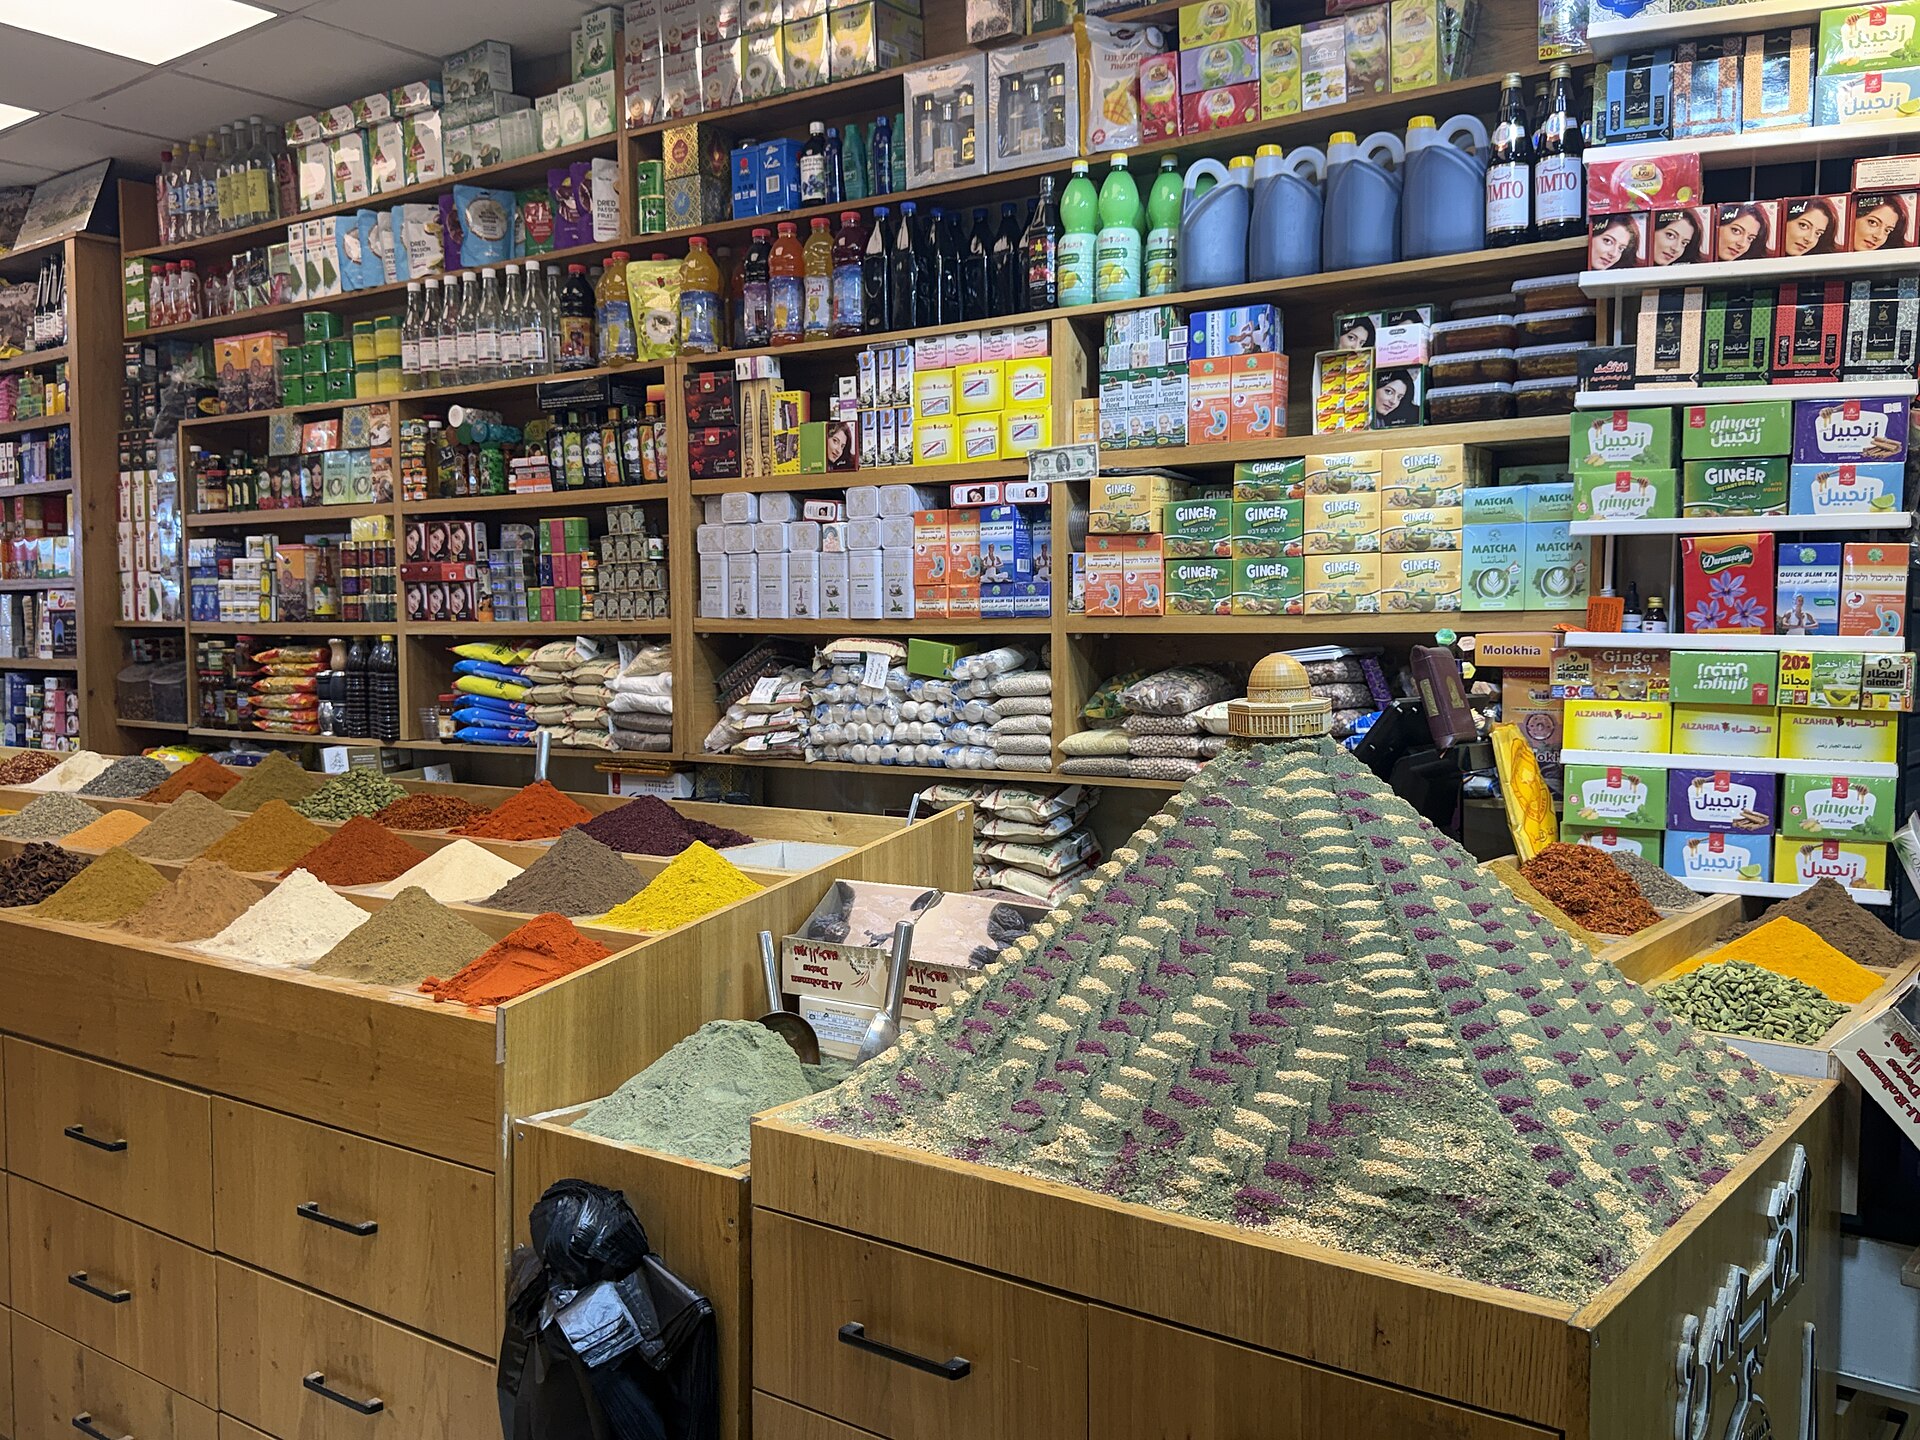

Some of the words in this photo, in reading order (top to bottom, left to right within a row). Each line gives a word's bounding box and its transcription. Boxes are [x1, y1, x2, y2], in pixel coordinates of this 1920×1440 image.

[1536, 171, 1578, 196] VIMTO
[1852, 334, 1862, 342] 45
[1709, 415, 1766, 434] ginger
[1823, 421, 1879, 442] زنجبيل
[1595, 432, 1645, 452] زنجبيل
[1710, 428, 1762, 448] زنجبيل
[1252, 462, 1286, 474] GINGER
[1324, 456, 1355, 466] GINGER
[1402, 454, 1442, 468] GINGER
[1704, 466, 1766, 486] GINGER
[1104, 483, 1137, 496] GINGER
[1203, 489, 1233, 501] GING
[1819, 487, 1875, 507] زنجبيل
[1323, 500, 1361, 514] GINGER
[1474, 497, 1514, 507] MATCHA
[1598, 494, 1650, 512] ginger
[1175, 505, 1217, 522] GINGER
[1245, 506, 1289, 522] GINGER
[1402, 512, 1435, 523] GINGER
[1472, 543, 1517, 554] MATCHA
[1535, 542, 1583, 553] MATCHA
[1178, 565, 1218, 580] GINGER
[1246, 563, 1289, 579] GINGER
[1322, 560, 1361, 574] GINGER
[1400, 558, 1441, 573] GINGER
[1779, 571, 1803, 579] QUICK
[1482, 645, 1541, 657] Molokhia
[1602, 651, 1659, 666] Ginger
[1781, 654, 1811, 670] 20%
[1781, 674, 1810, 686] مجانا
[1867, 668, 1904, 679] العطار
[1693, 675, 1748, 694] ginger
[1865, 679, 1903, 688] alattar
[1564, 686, 1582, 698] 3X
[1574, 710, 1613, 719] ALZAHRA
[1623, 711, 1662, 720] الزهراء
[1793, 717, 1834, 726] ALZAHRA
[1846, 718, 1889, 728] الزهراء
[1680, 722, 1720, 732] ALZAHRA
[1731, 724, 1772, 734] الزهراء
[1589, 790, 1641, 806] ginger
[1695, 793, 1748, 812] زنجبيل
[1812, 800, 1869, 818] ginger
[1690, 853, 1742, 873] زنجبيل
[803, 963, 829, 977] Dates
[790, 974, 843, 991] Al-Rohman
[908, 984, 937, 999] Dates
[1886, 1057, 1920, 1100] Dates
